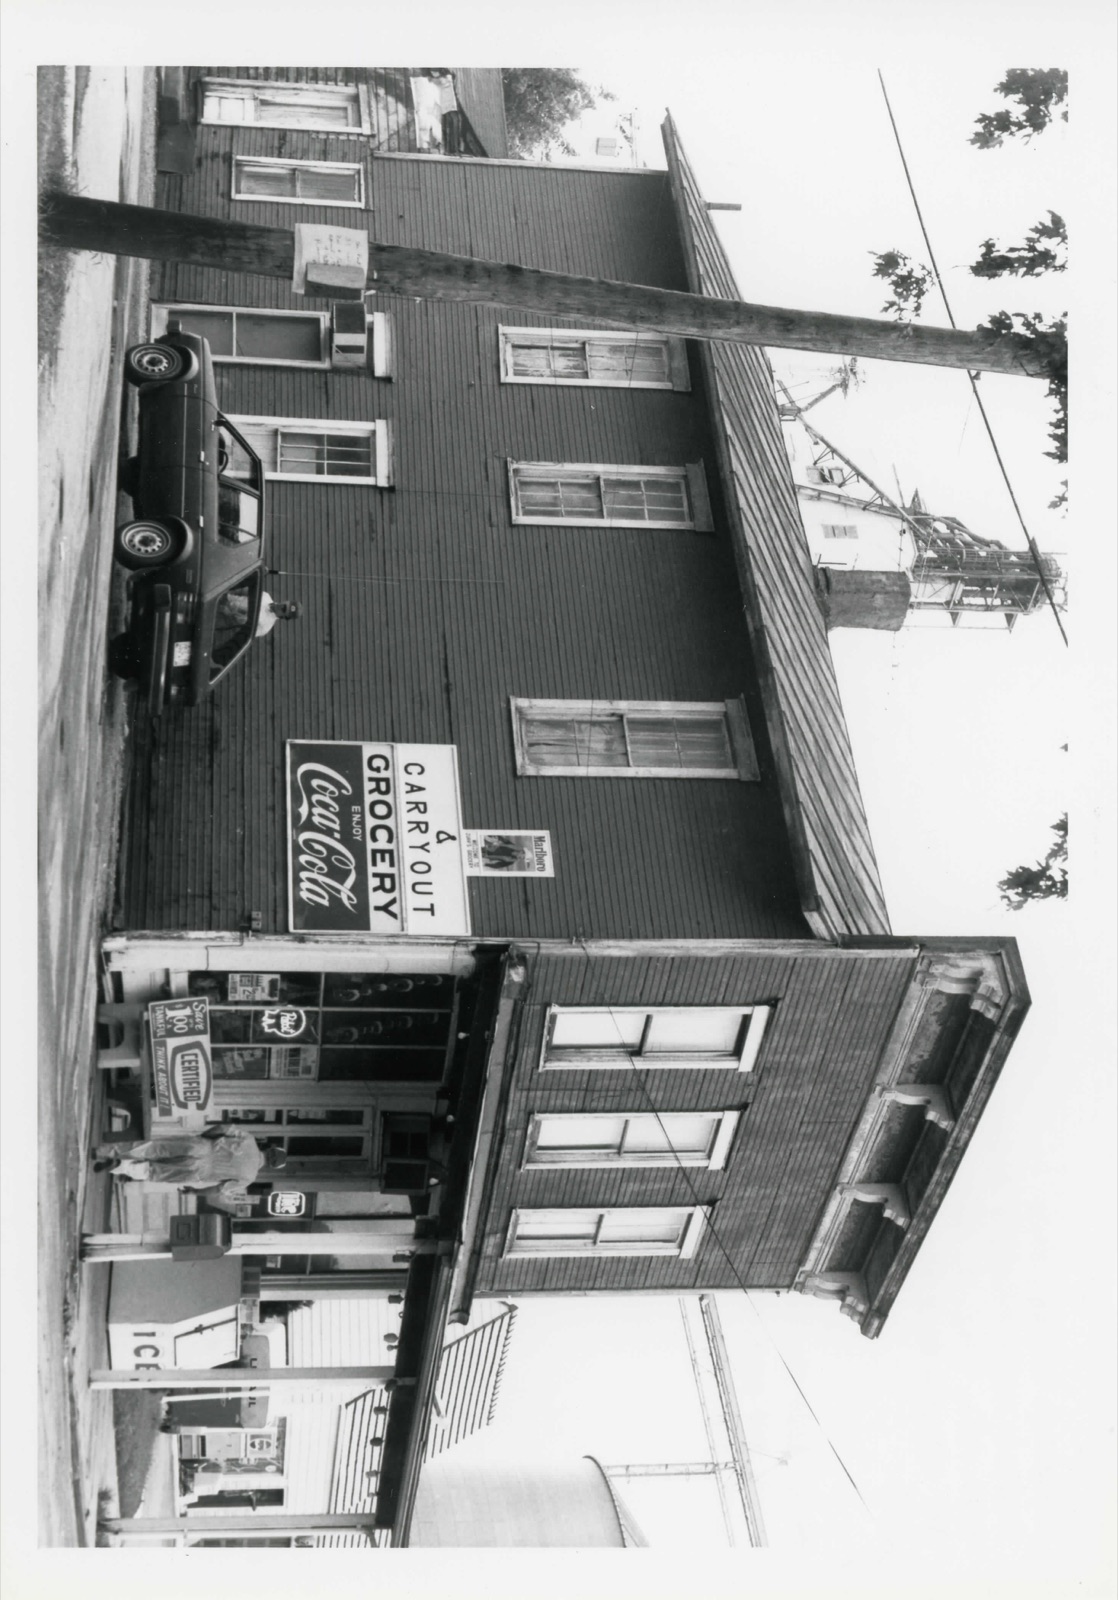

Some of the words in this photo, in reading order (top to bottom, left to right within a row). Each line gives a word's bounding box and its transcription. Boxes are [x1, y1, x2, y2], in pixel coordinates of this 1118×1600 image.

[350, 806, 361, 842] ENJOY
[366, 754, 397, 920] GROCERY
[435, 830, 456, 844] &
[533, 836, 546, 872] Marlboro
[154, 1005, 166, 1038] TANKFUL
[192, 1002, 206, 1030] Save
[155, 1046, 166, 1070] THINK
[157, 1071, 168, 1096] ABOUT
[180, 1052, 201, 1102] CERTIFIED
